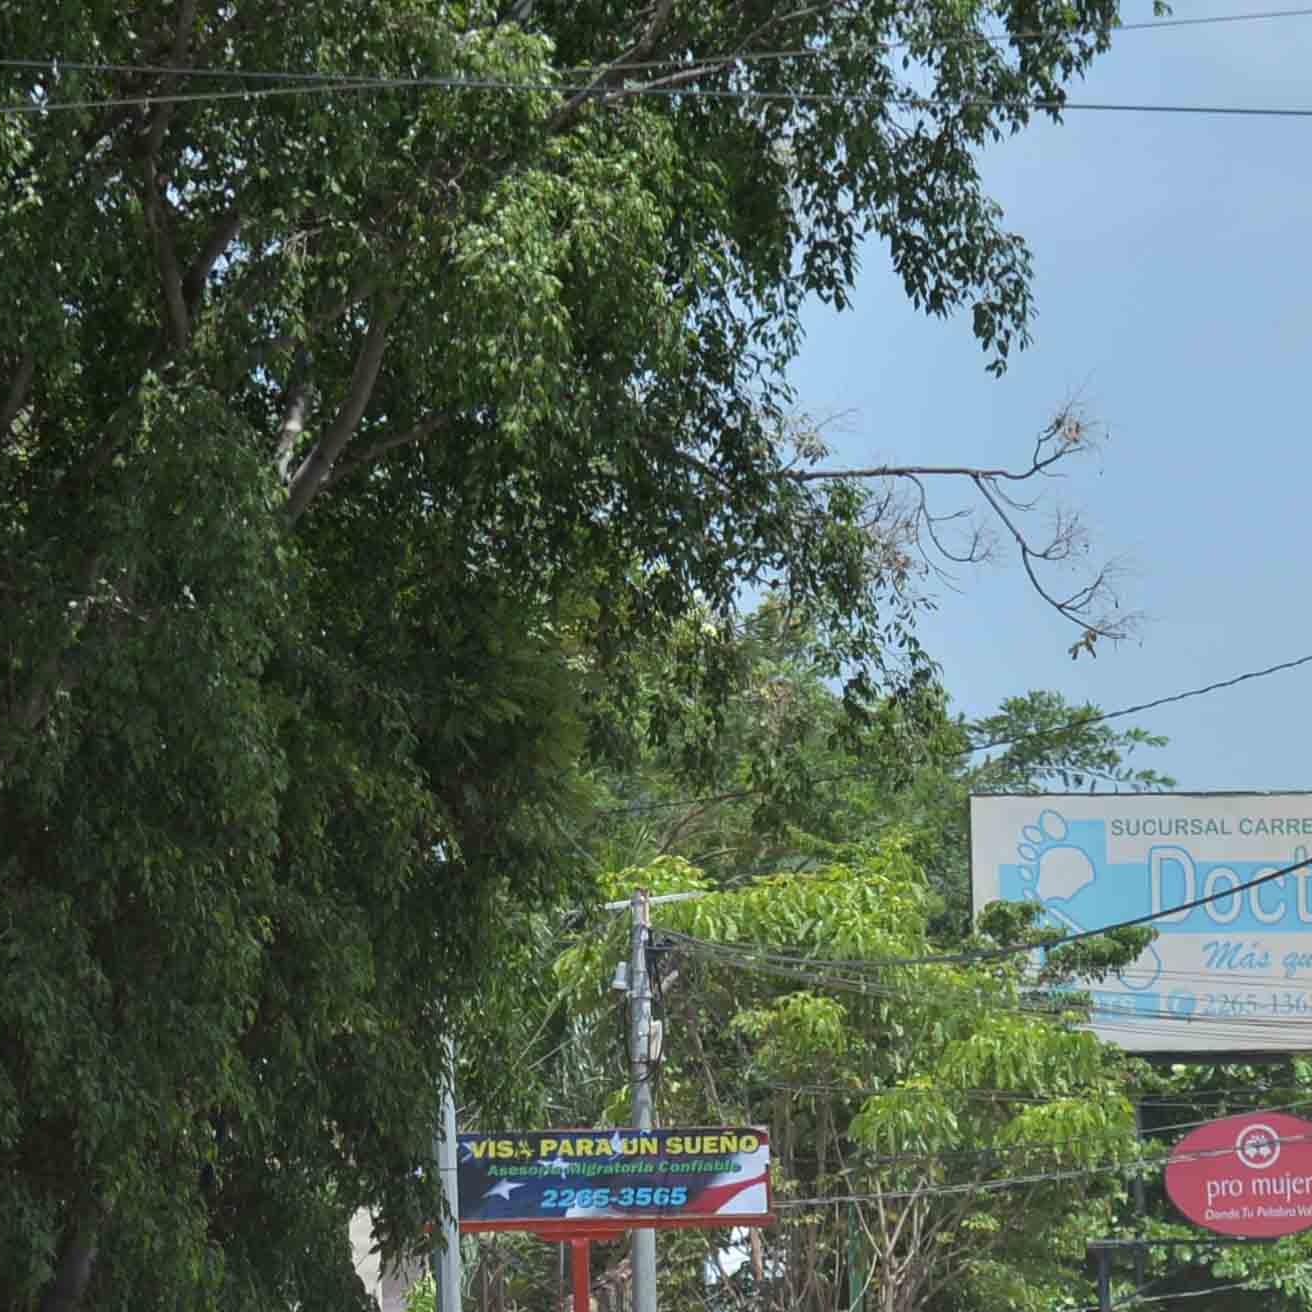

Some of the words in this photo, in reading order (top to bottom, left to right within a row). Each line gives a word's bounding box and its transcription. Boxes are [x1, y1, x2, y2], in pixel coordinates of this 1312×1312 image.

[1111, 818, 1232, 836] SUCURSAL
[1201, 940, 1272, 970] Más
[540, 1138, 612, 1158] PARA
[622, 1136, 658, 1156] UN
[665, 1131, 760, 1155] SUEÑO
[540, 1186, 688, 1209] 2265-3565
[1205, 1178, 1243, 1207] pro
